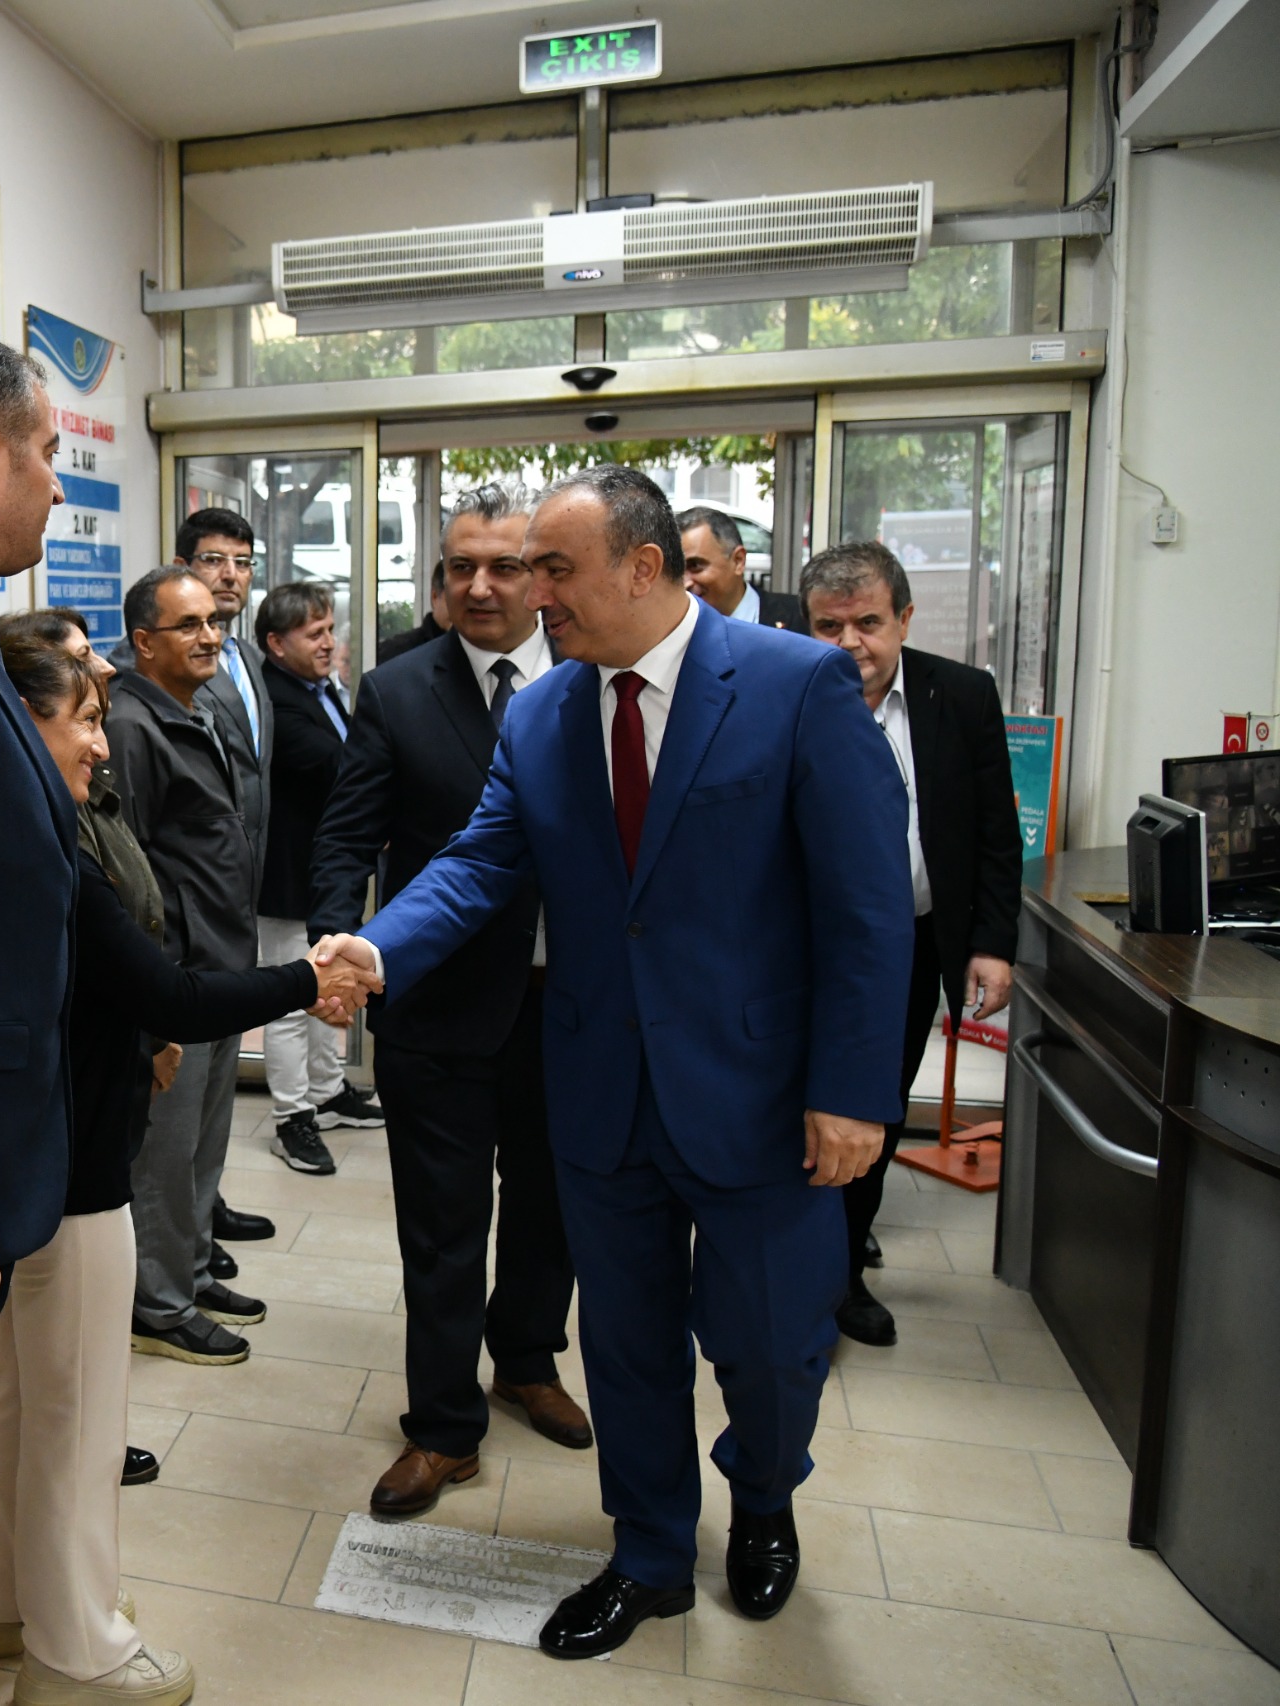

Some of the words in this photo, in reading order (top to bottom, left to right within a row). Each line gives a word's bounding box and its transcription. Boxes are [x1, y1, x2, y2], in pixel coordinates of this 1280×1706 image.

[550, 32, 631, 57] EXIT
[540, 48, 641, 80] ÇIKIŞ
[82, 450, 96, 473] KAT
[74, 514, 81, 534] 2.
